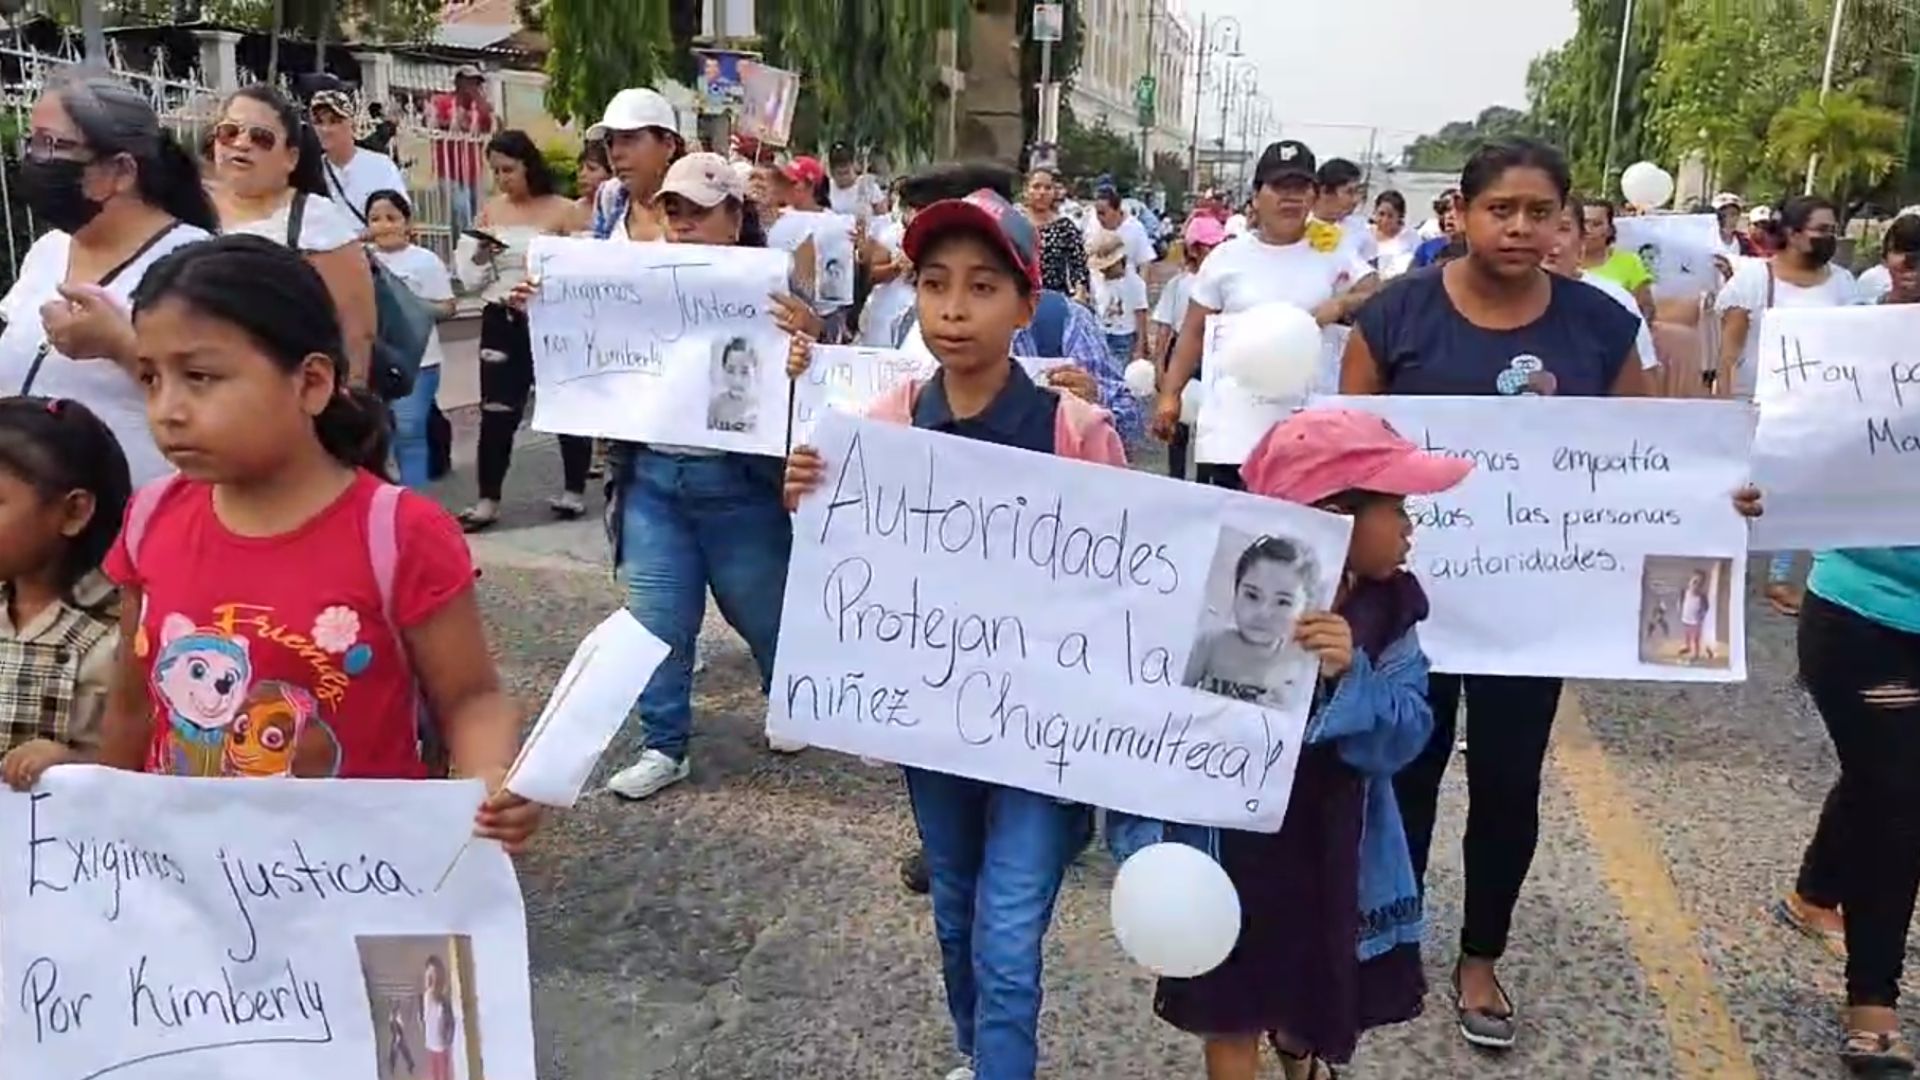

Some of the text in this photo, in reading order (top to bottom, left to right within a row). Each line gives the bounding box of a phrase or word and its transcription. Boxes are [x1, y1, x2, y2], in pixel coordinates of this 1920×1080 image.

[645, 263, 757, 343] Justicia
[1772, 335, 1864, 403] Hoy
[1553, 437, 1670, 492] empatía
[820, 431, 1178, 594] Autoridades
[1507, 492, 1550, 526] las
[1563, 507, 1682, 550] personas
[824, 557, 1173, 688] Protejan a la
[787, 672, 920, 727] niñez
[21, 955, 333, 1043] Por Kimberly
